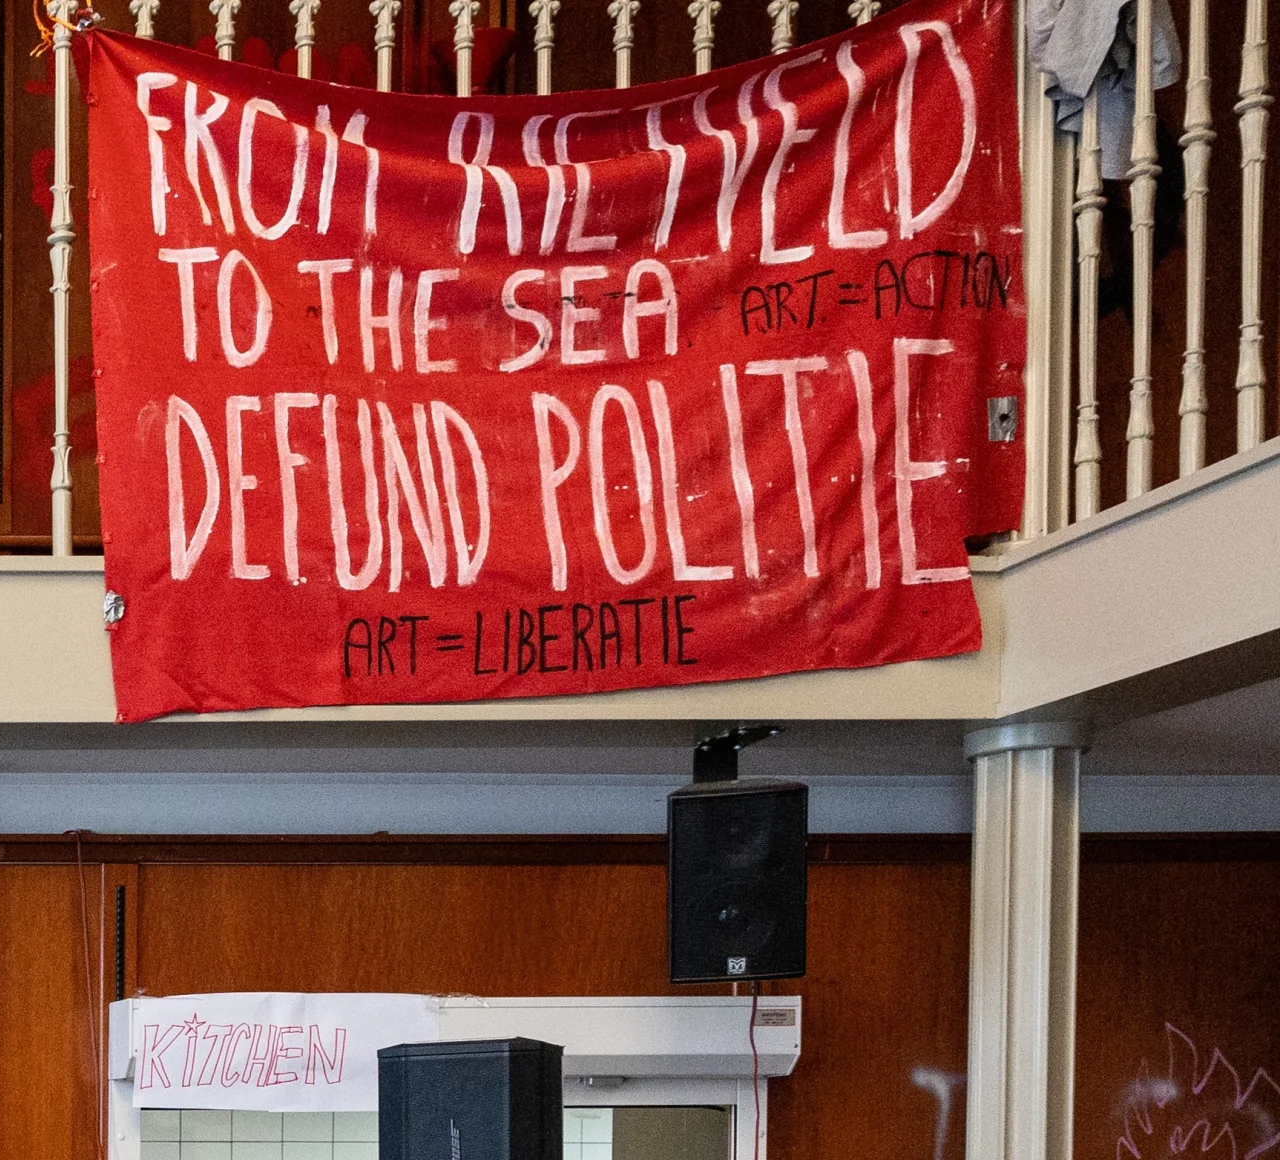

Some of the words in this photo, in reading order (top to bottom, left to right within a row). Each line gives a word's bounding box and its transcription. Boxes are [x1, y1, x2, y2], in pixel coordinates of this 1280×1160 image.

[136, 72, 379, 241] FROM
[447, 20, 978, 265] RIETVELD
[158, 247, 272, 368] TO
[297, 258, 459, 373] THE
[498, 258, 680, 373] SEA
[874, 249, 1011, 320] ACTION
[166, 391, 491, 594] DEFUND
[532, 337, 971, 594] POLITIE
[344, 615, 429, 678] ART
[474, 595, 698, 676] LIBERATIE
